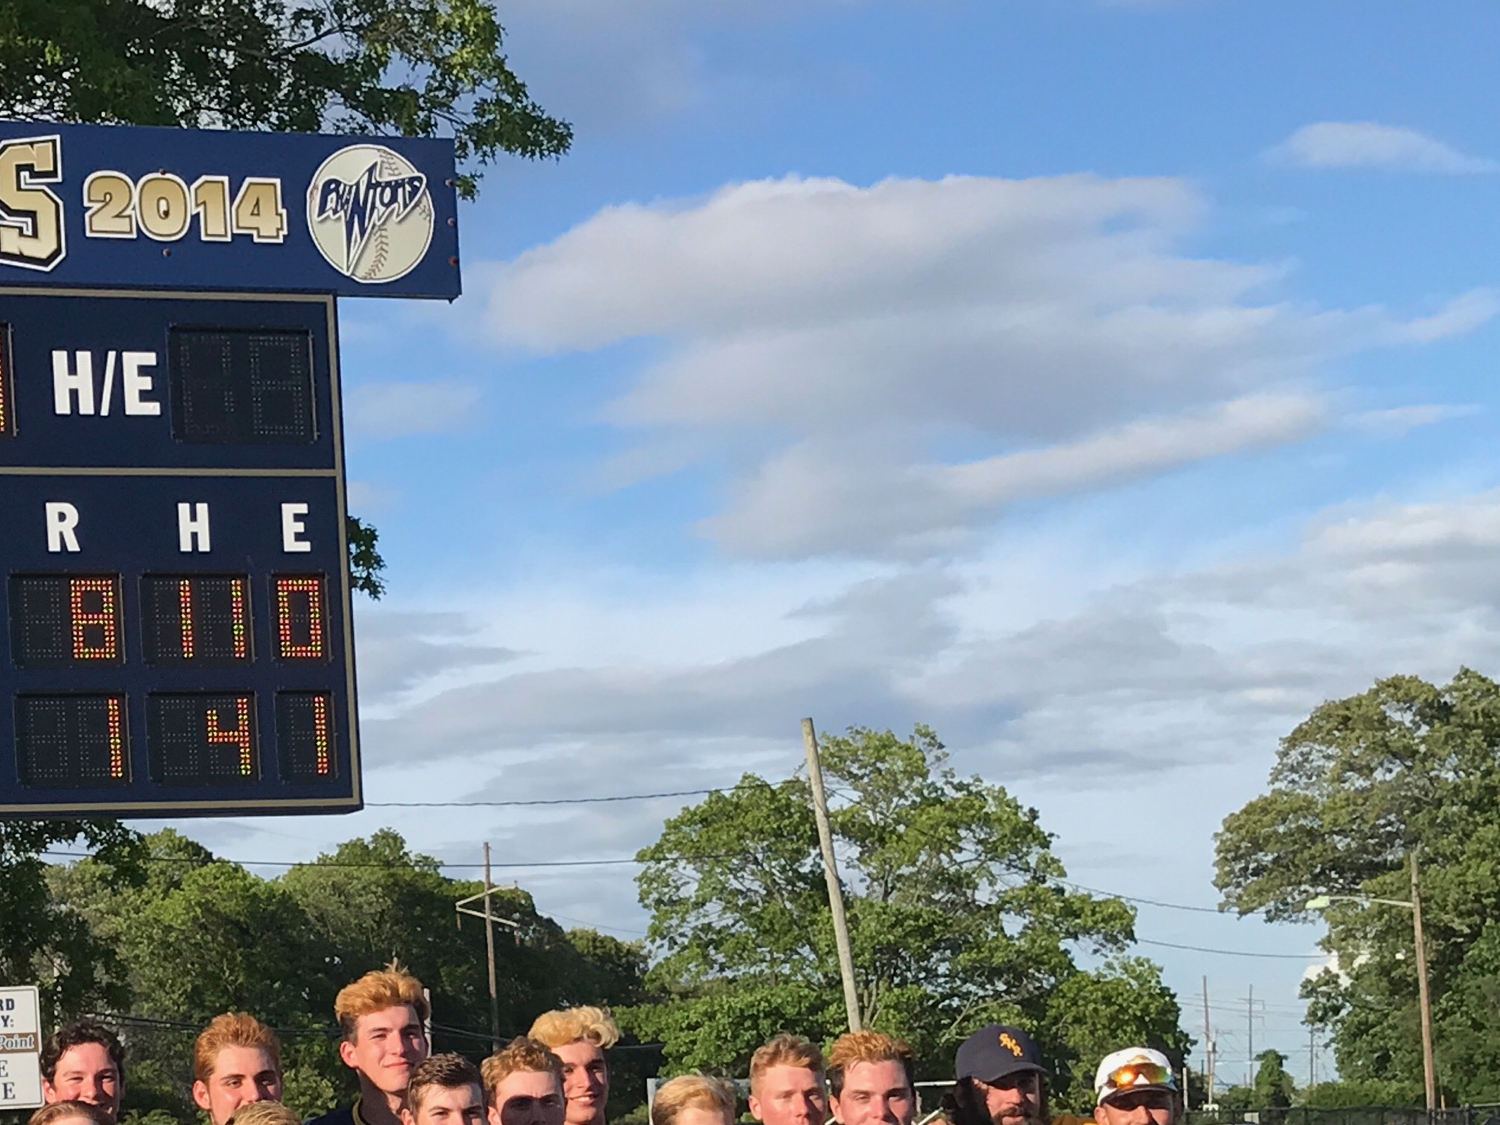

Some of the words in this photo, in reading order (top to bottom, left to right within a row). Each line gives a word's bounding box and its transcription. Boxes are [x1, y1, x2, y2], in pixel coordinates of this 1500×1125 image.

[83, 170, 288, 244] 2014
[52, 350, 161, 417] H/E
[45, 502, 80, 553] R
[177, 502, 211, 553] H
[281, 503, 311, 553] E
[69, 578, 117, 660] 8
[276, 578, 322, 658] 0
[107, 697, 123, 778] 1
[206, 697, 252, 776] 4
[313, 696, 329, 775] 1
